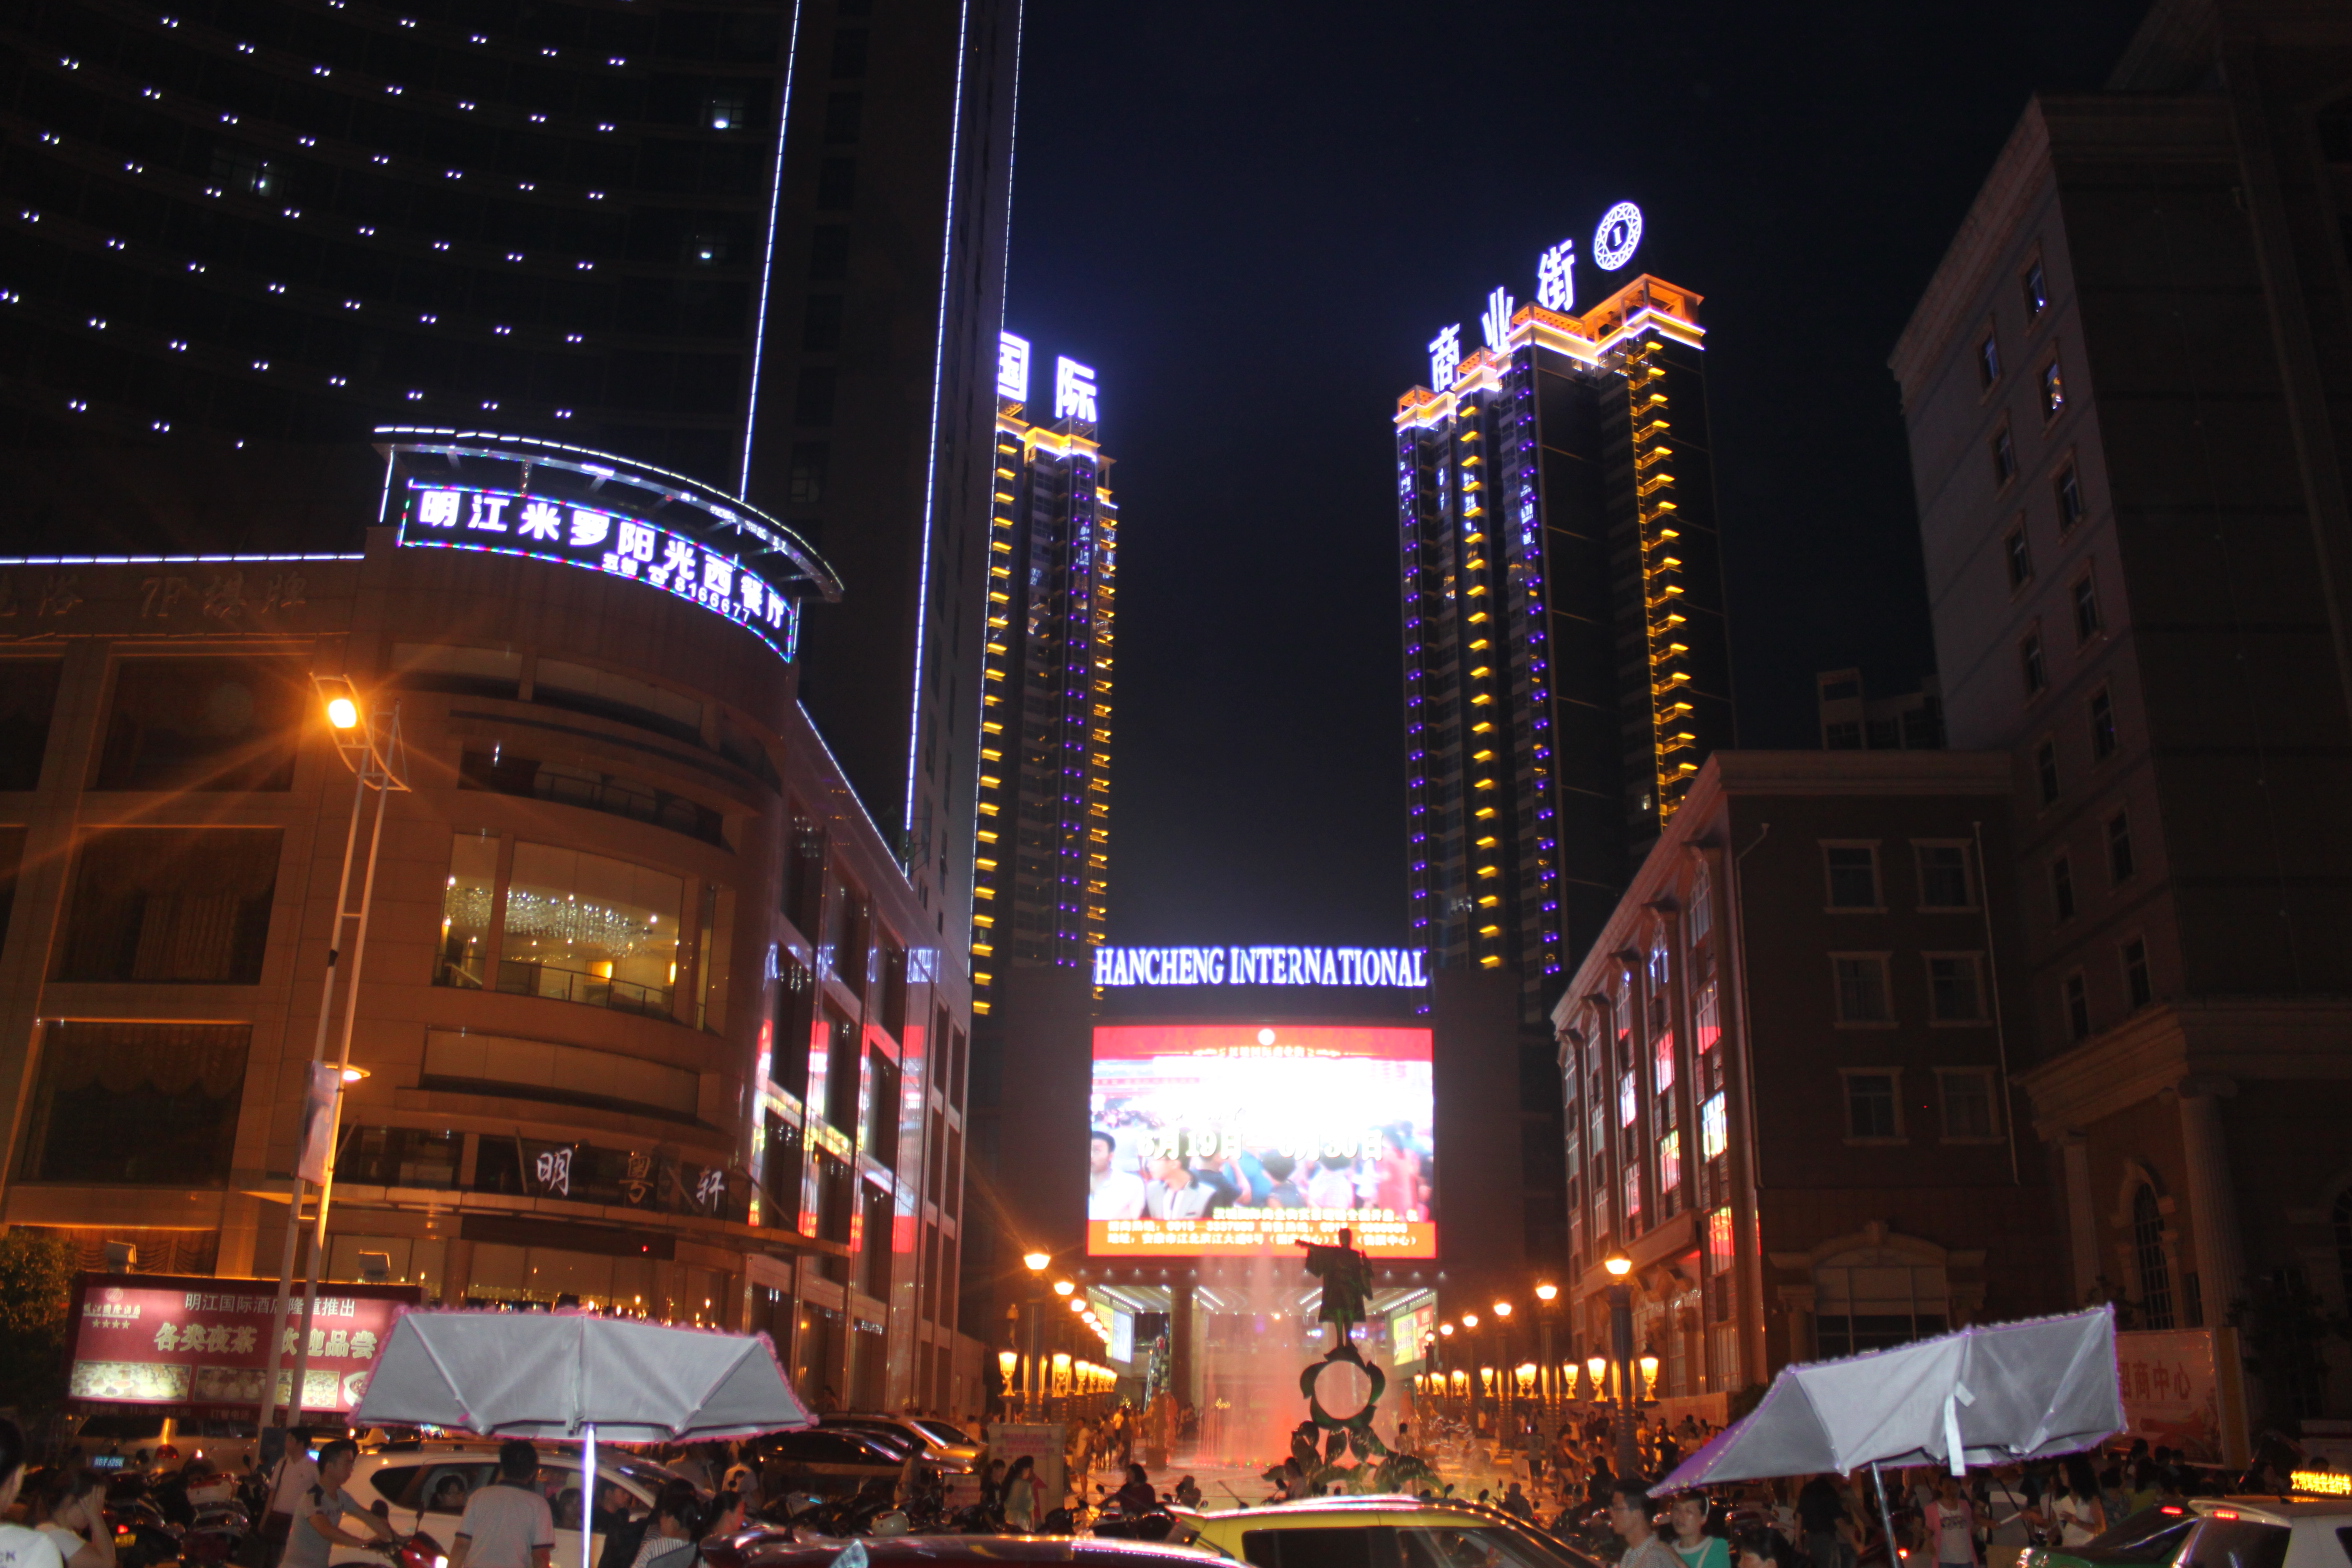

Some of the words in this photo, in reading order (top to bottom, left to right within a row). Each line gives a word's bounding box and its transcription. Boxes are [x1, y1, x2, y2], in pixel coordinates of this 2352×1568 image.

[1428, 239, 1575, 393] 商业街
[997, 331, 1098, 423] 国际
[418, 489, 785, 629] 明江米罗阳光西餐厅
[674, 575, 751, 623] 8166677
[1094, 945, 1225, 987] HANCHENG
[1229, 946, 1428, 988] INTERNATIONAL
[536, 1147, 726, 1213] 明粤轩
[154, 1322, 258, 1354] 各类夜茶
